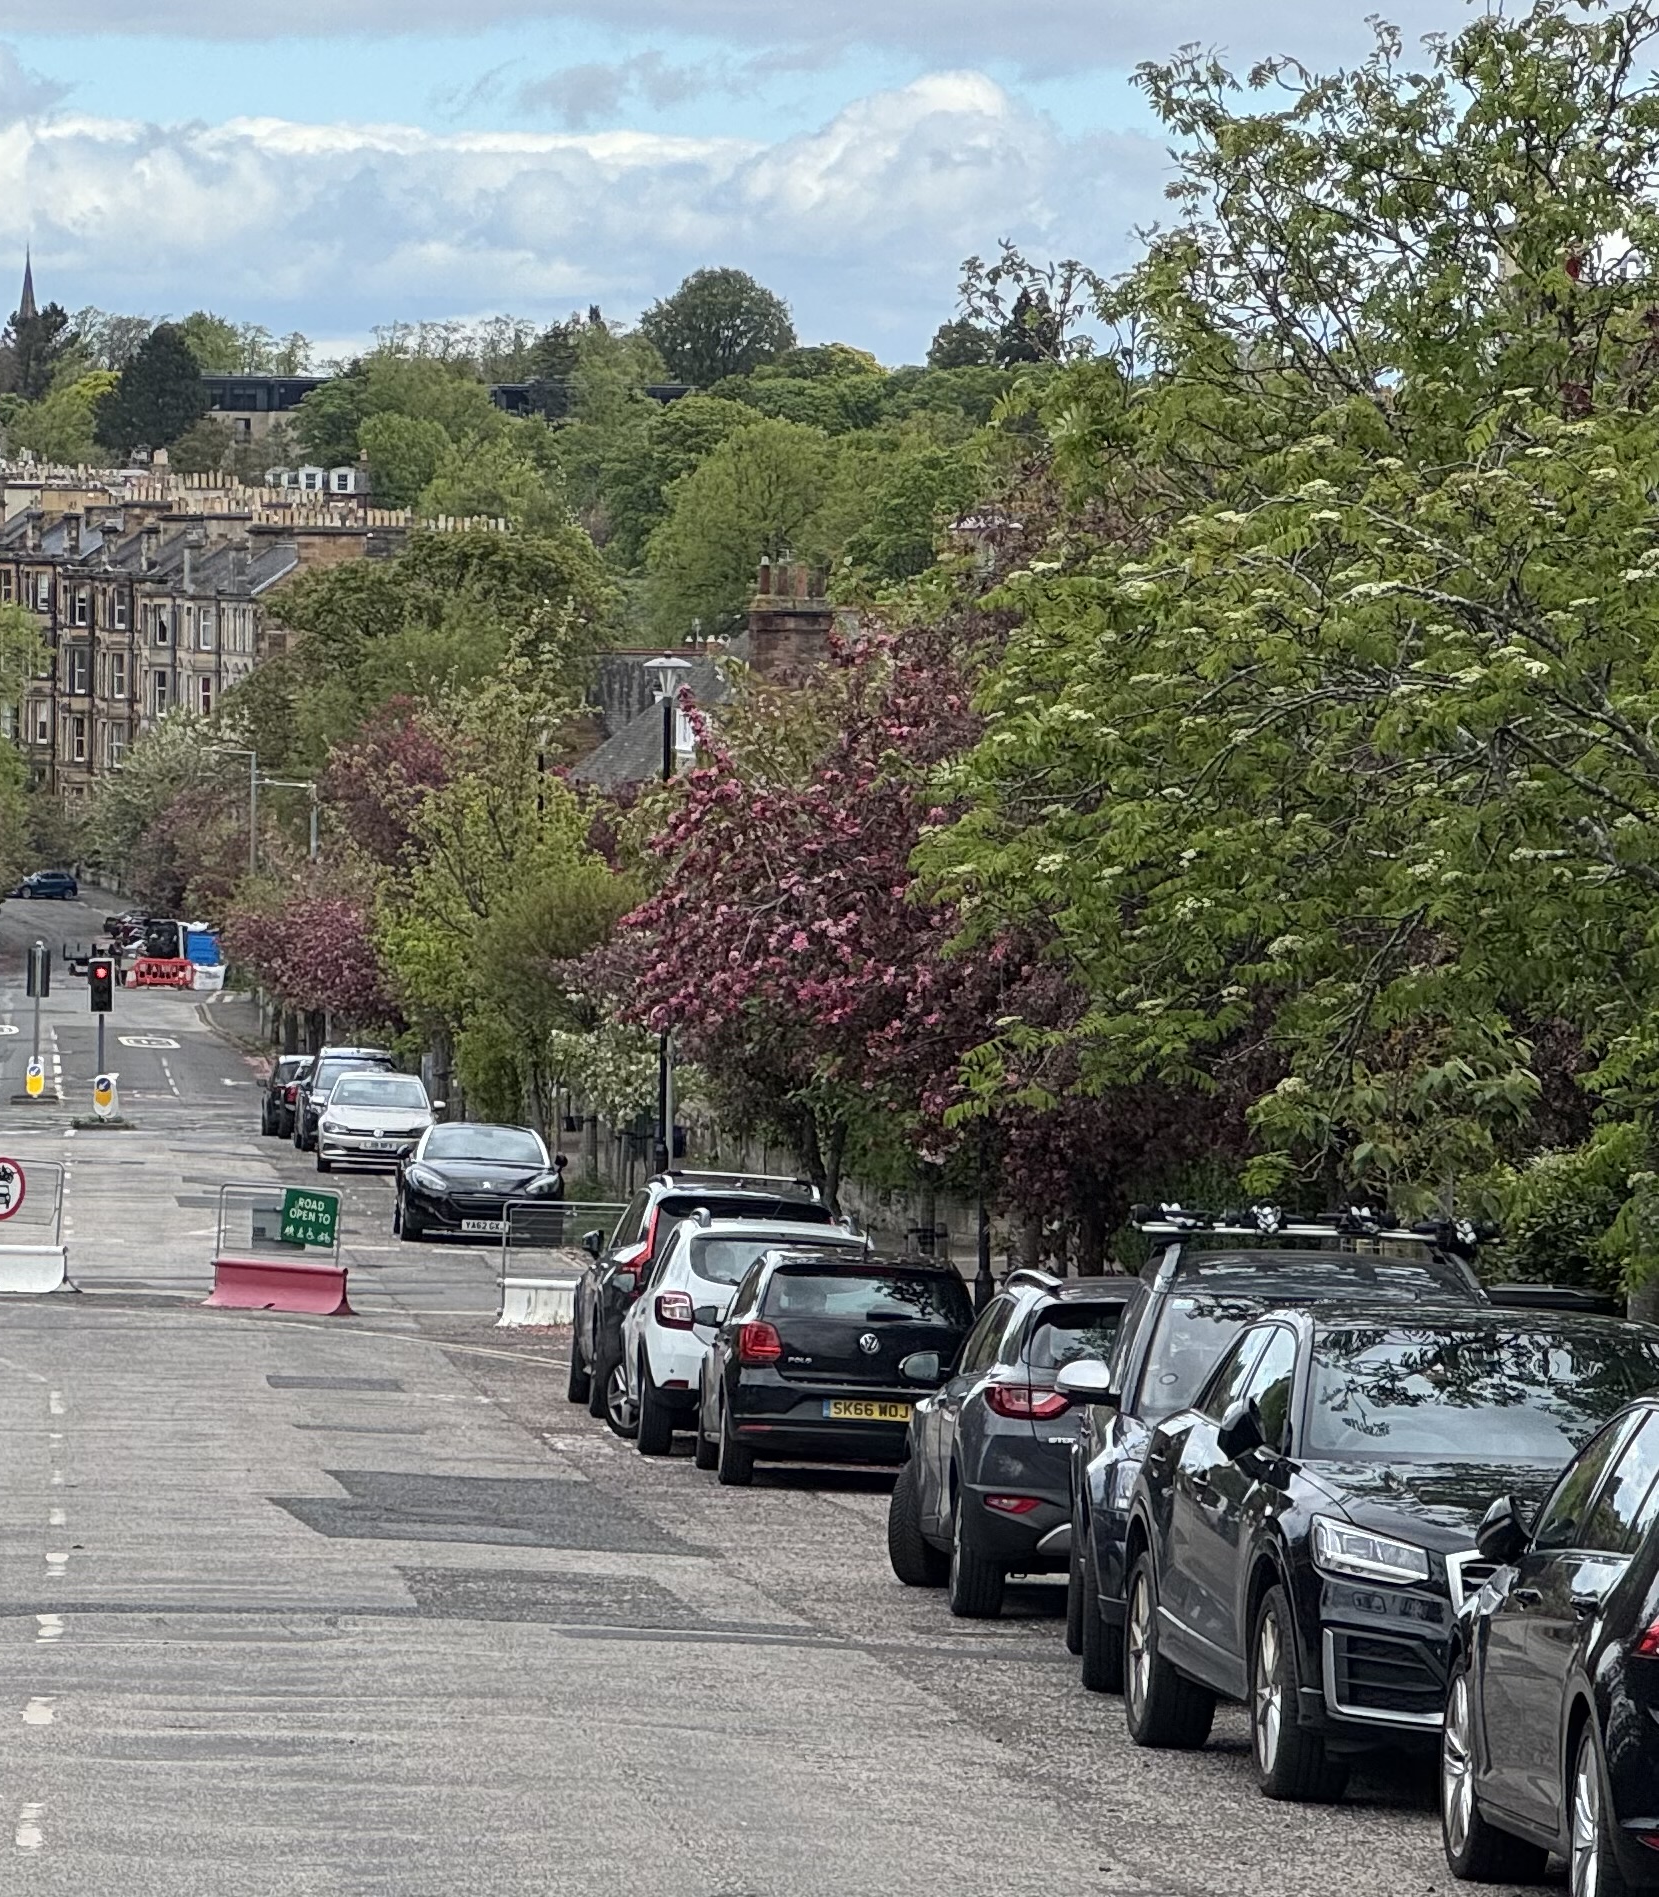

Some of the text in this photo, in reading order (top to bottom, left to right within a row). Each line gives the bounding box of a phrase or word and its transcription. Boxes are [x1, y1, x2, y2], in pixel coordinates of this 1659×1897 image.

[298, 1196, 325, 1211] ROAD
[289, 1207, 331, 1225] OPEN TO
[465, 1221, 488, 1230] YA62
[833, 1401, 909, 1418] SK66 WOJ
